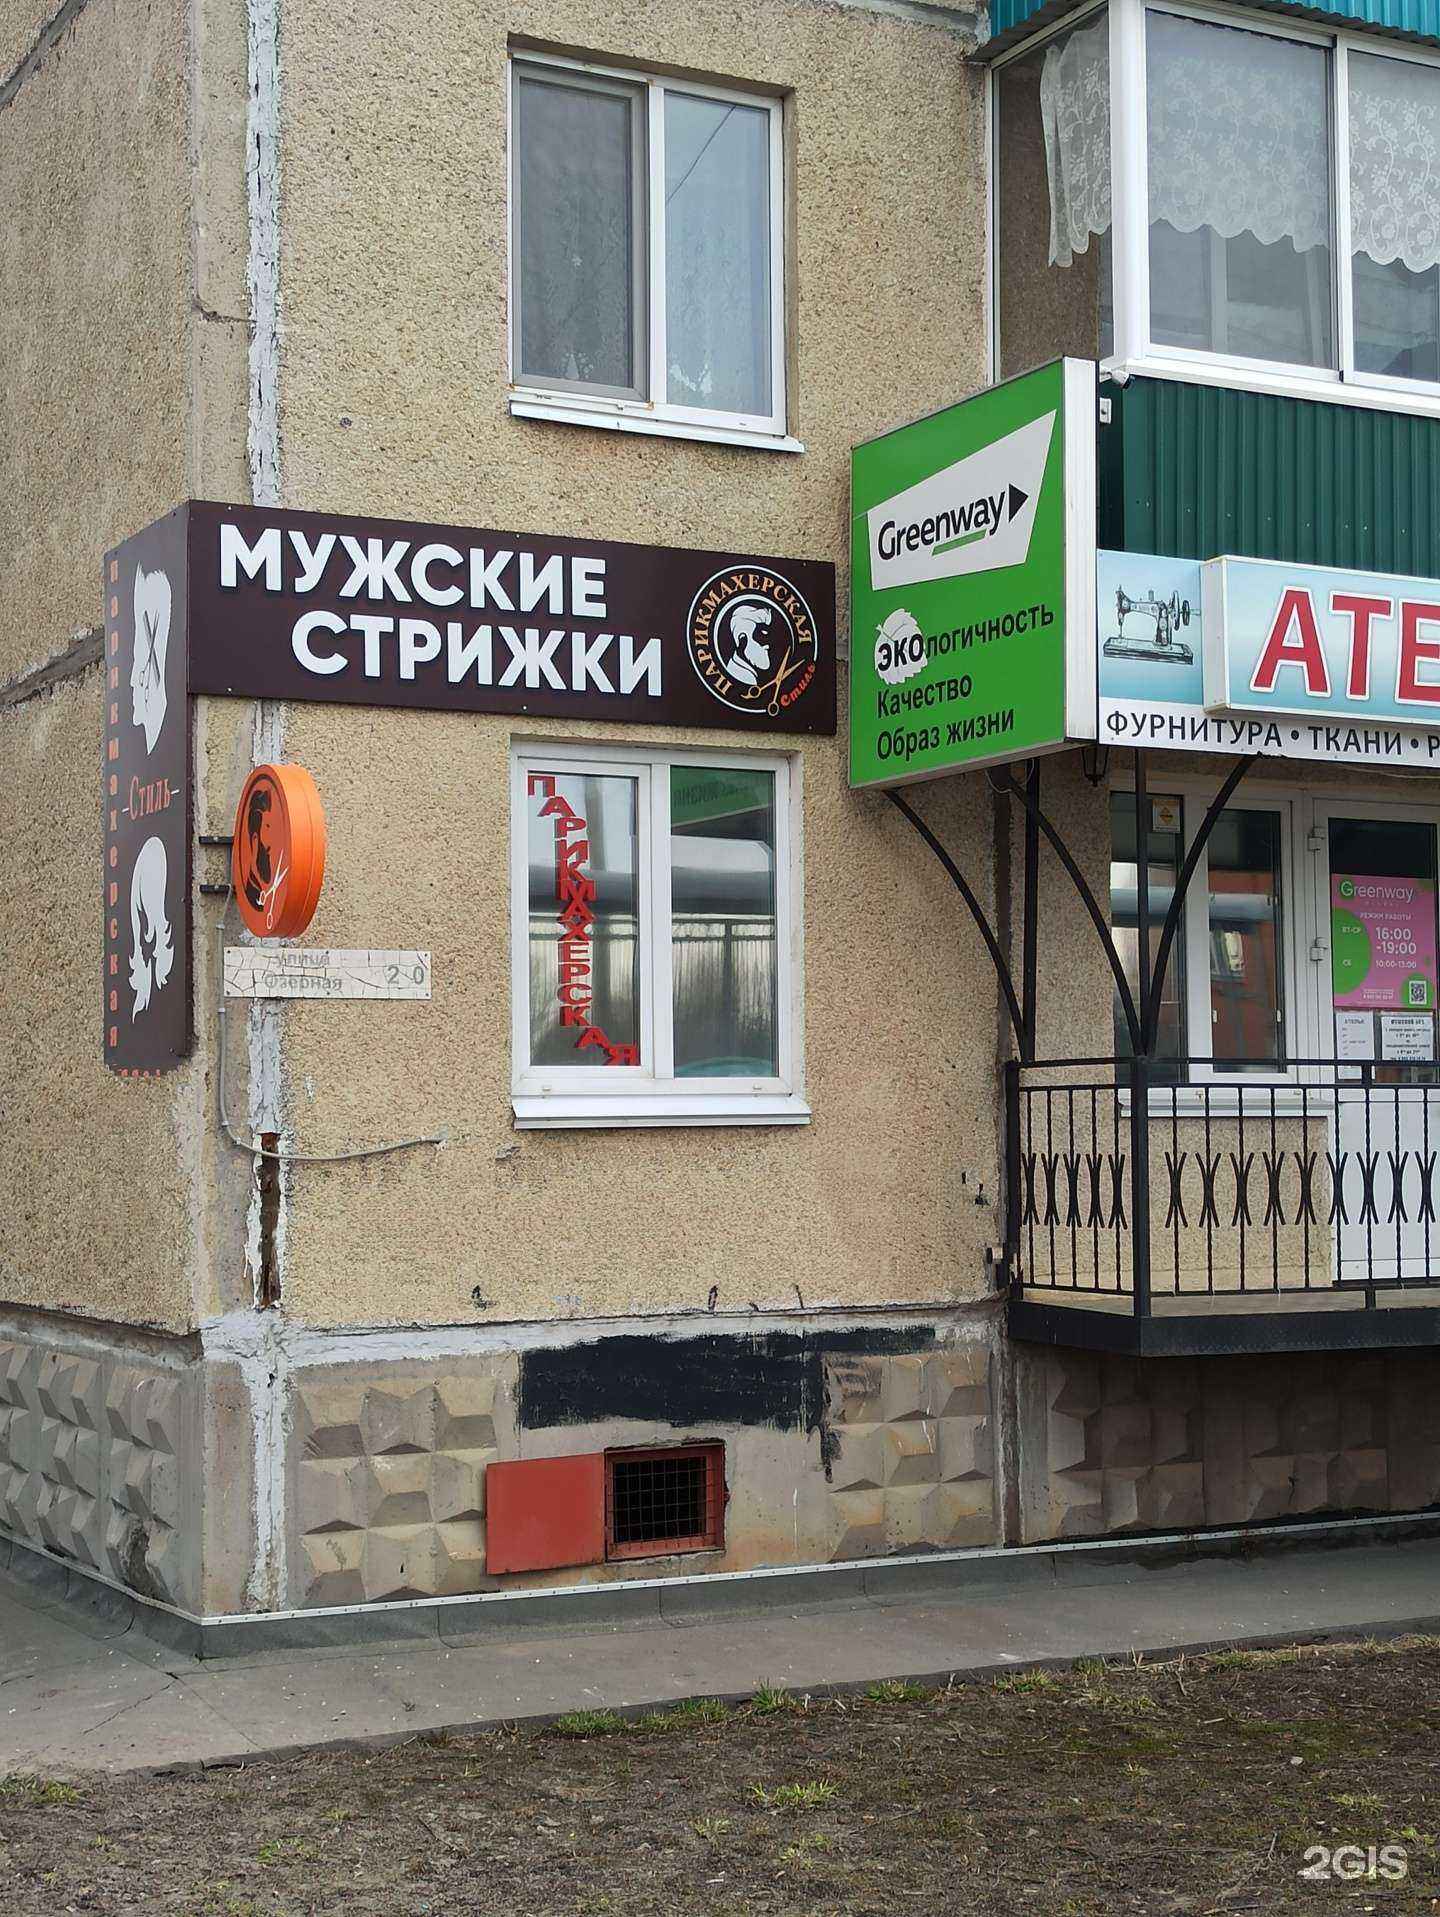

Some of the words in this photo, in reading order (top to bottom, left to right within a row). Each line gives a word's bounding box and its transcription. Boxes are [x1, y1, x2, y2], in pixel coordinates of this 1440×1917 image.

[878, 491, 1005, 560] Greenway
[220, 523, 607, 618] МУЖСКИЕ
[291, 610, 662, 697] СТРИЖКИ
[694, 574, 812, 696] ПАРИКМАХЕРСКАЯ
[780, 663, 816, 706] Стиль
[877, 675, 972, 719] Качество
[877, 725, 940, 762] Образ
[946, 708, 1014, 746] жизни
[1106, 710, 1282, 747] ФУРНИТУРА
[1308, 726, 1402, 755] ТКАНИ
[1341, 881, 1414, 904] Greenway
[527, 775, 640, 1066] ПАРИКМАХЕРСКАЯ
[1376, 927, 1411, 940] 16:00
